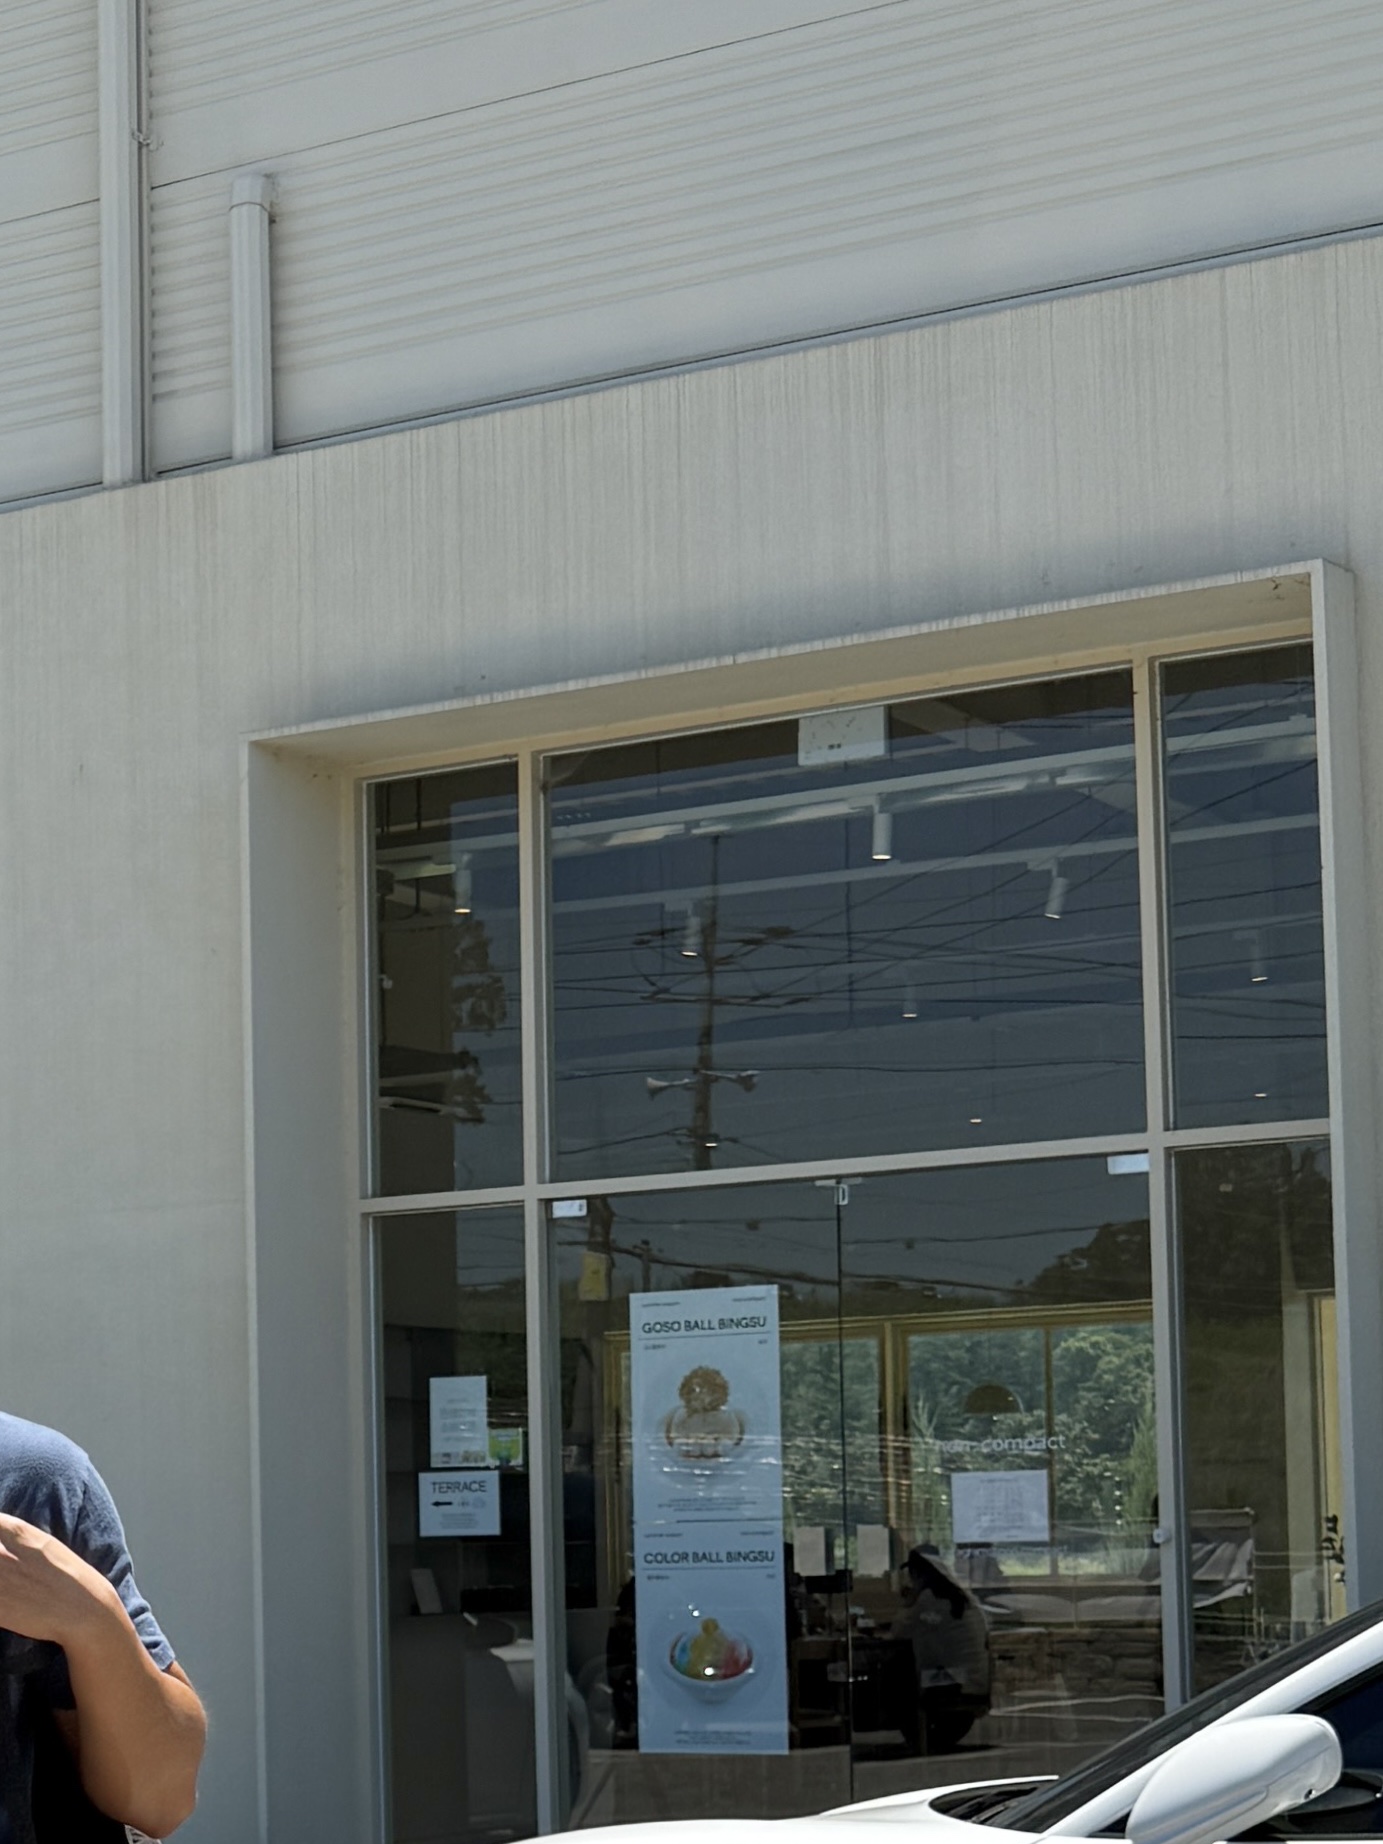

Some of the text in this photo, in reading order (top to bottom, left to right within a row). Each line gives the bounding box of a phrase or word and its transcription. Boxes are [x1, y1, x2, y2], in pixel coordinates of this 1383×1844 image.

[642, 1316, 767, 1333] GOSO BALL BINGSU
[431, 1480, 487, 1494] TERRACE
[644, 1550, 774, 1564] COLOR BALL BINGSU
